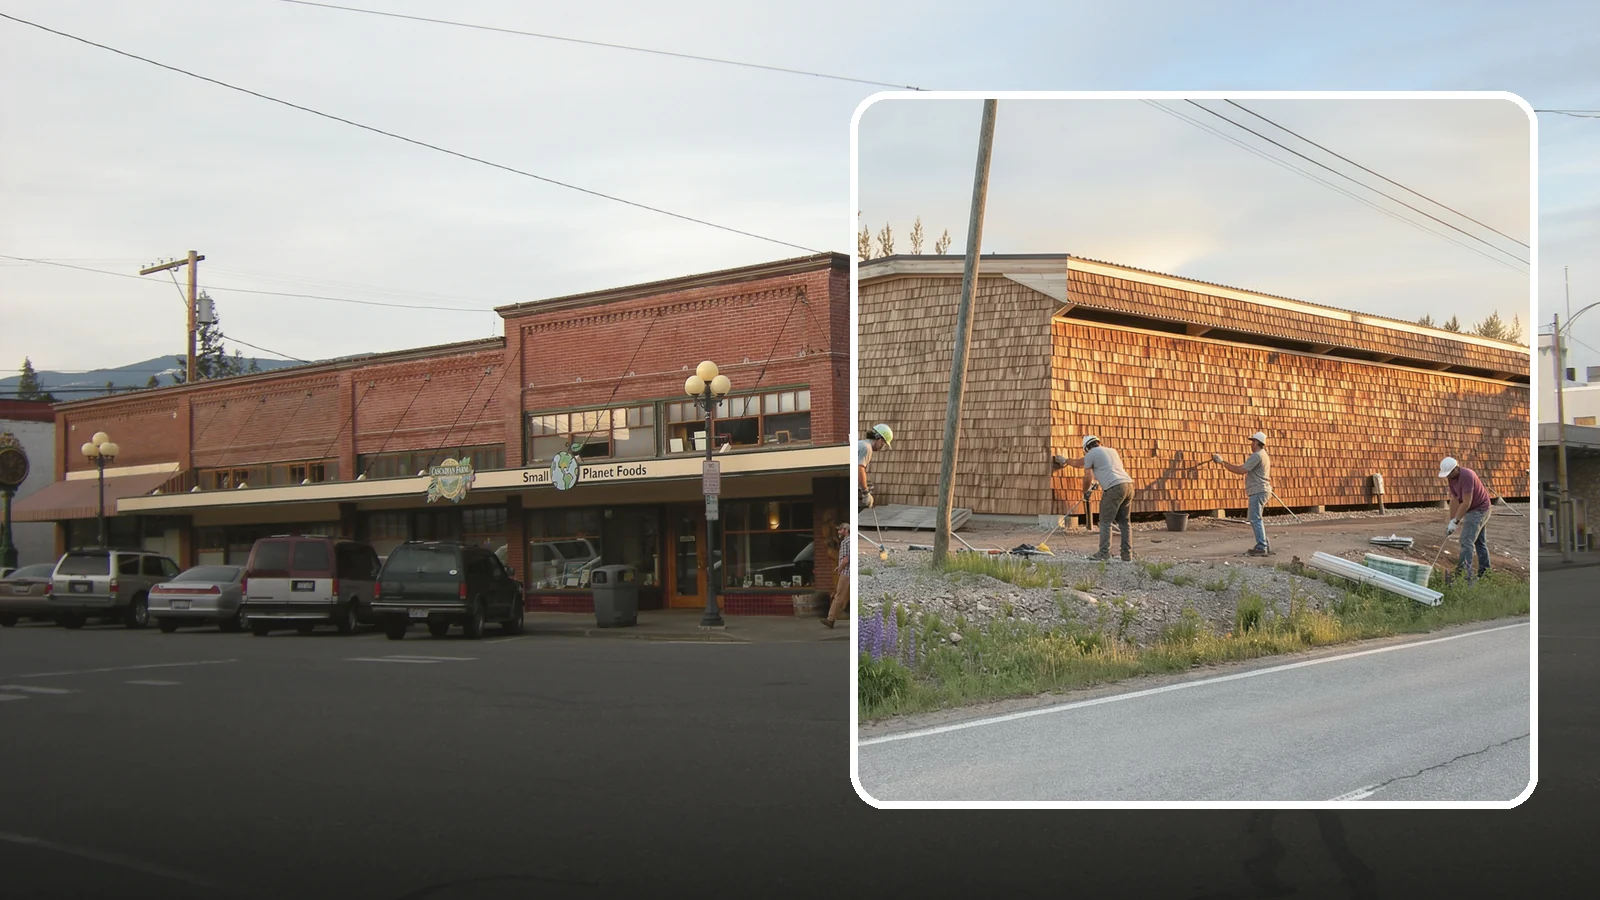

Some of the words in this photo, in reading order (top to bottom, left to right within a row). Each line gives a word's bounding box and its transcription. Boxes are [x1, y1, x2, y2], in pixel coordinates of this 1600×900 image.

[523, 471, 549, 482] Small
[582, 467, 614, 479] Planet
[617, 464, 647, 477] Foods
